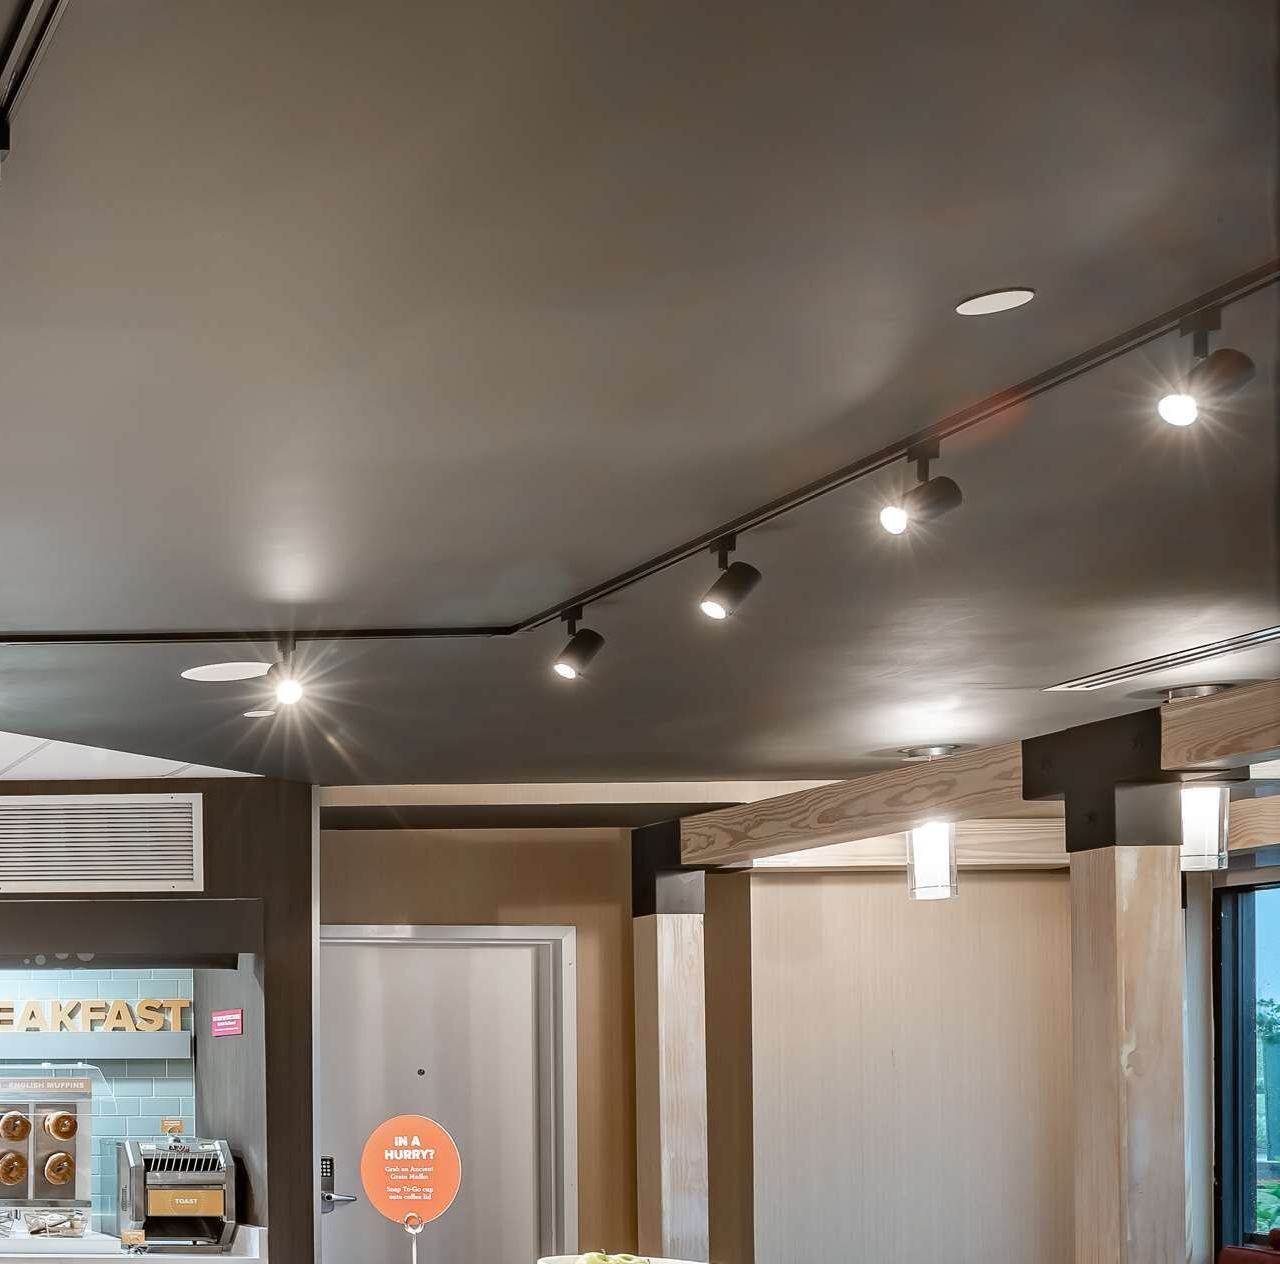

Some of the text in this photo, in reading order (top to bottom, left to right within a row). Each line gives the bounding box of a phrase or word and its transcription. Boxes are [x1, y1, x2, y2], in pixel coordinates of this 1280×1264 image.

[394, 1136, 420, 1146] IN A
[385, 1149, 434, 1160] HURRY?
